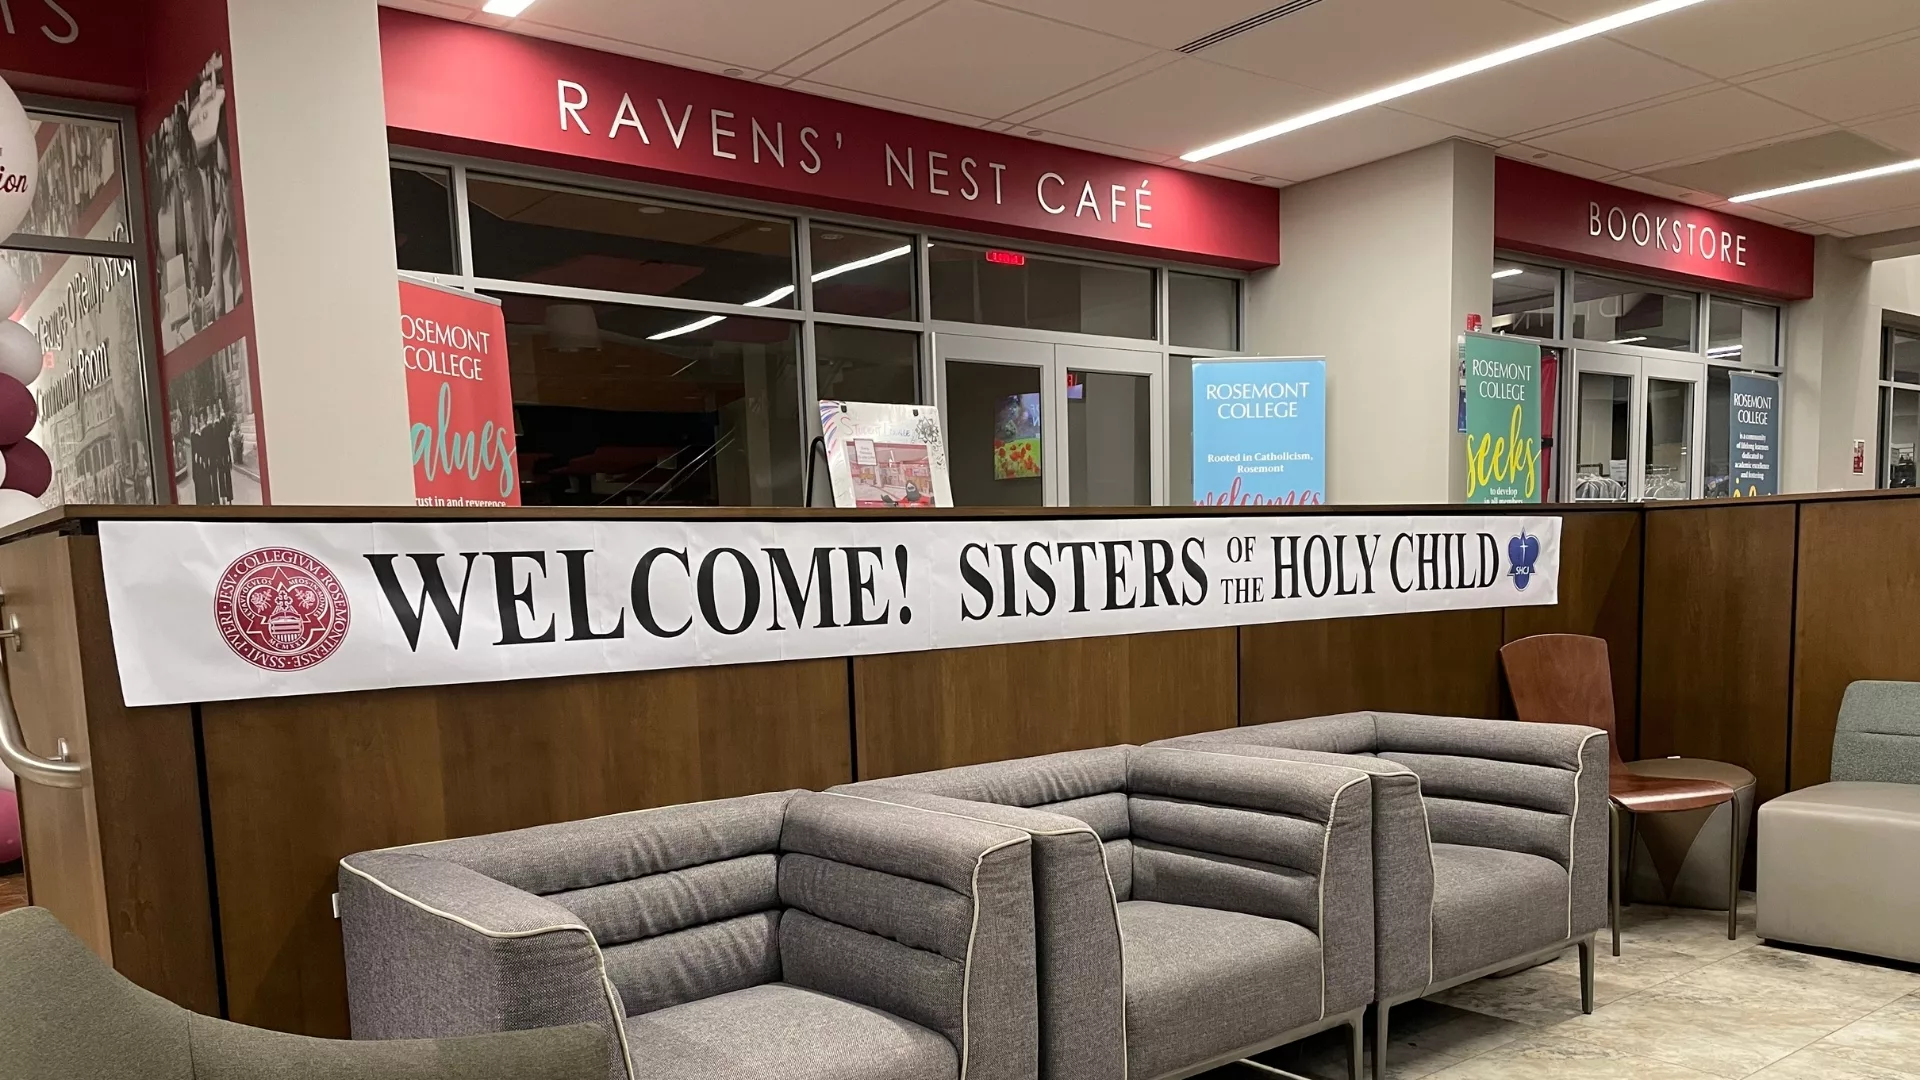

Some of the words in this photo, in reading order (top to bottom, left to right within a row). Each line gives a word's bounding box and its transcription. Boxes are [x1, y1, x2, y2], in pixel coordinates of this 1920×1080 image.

[557, 79, 842, 174] RAVENS'
[885, 143, 1006, 205] NEST
[1037, 172, 1152, 228] CAFÉ
[1589, 202, 1746, 266] BOOKSTORE
[400, 314, 490, 354] OSEMONT
[77, 341, 110, 394] Room
[403, 345, 483, 381] COLLEGE
[1472, 359, 1531, 381] ROSEMONT
[1206, 382, 1310, 399] ROSEMONT
[1479, 381, 1525, 400] COLLEGE
[1734, 393, 1772, 409] ROSEMONT
[1217, 402, 1298, 419] COLLEGE
[1738, 410, 1768, 425] COLLEGE
[410, 382, 516, 498] alues
[1467, 404, 1541, 498] seeks
[1207, 454, 1240, 463] Rooted
[1242, 453, 1252, 462] in
[1254, 452, 1313, 462] Catholicism,
[1237, 464, 1284, 473] Rosemont
[415, 496, 433, 507] rust
[434, 496, 444, 507] in
[446, 496, 463, 507] and
[1490, 487, 1496, 496] to
[1497, 486, 1517, 498] develop
[235, 550, 321, 575] COLLEGIVM
[1227, 536, 1256, 563] OF
[1271, 534, 1381, 599] HOLY
[1389, 532, 1500, 594] CHILD
[1515, 566, 1530, 575] SHCJ
[362, 543, 912, 652] WELCOME!
[959, 536, 1208, 622] SISTERS
[1221, 577, 1264, 605] THE
[218, 610, 246, 651] PVERI
[292, 574, 347, 668] ROSEMONTENSE
